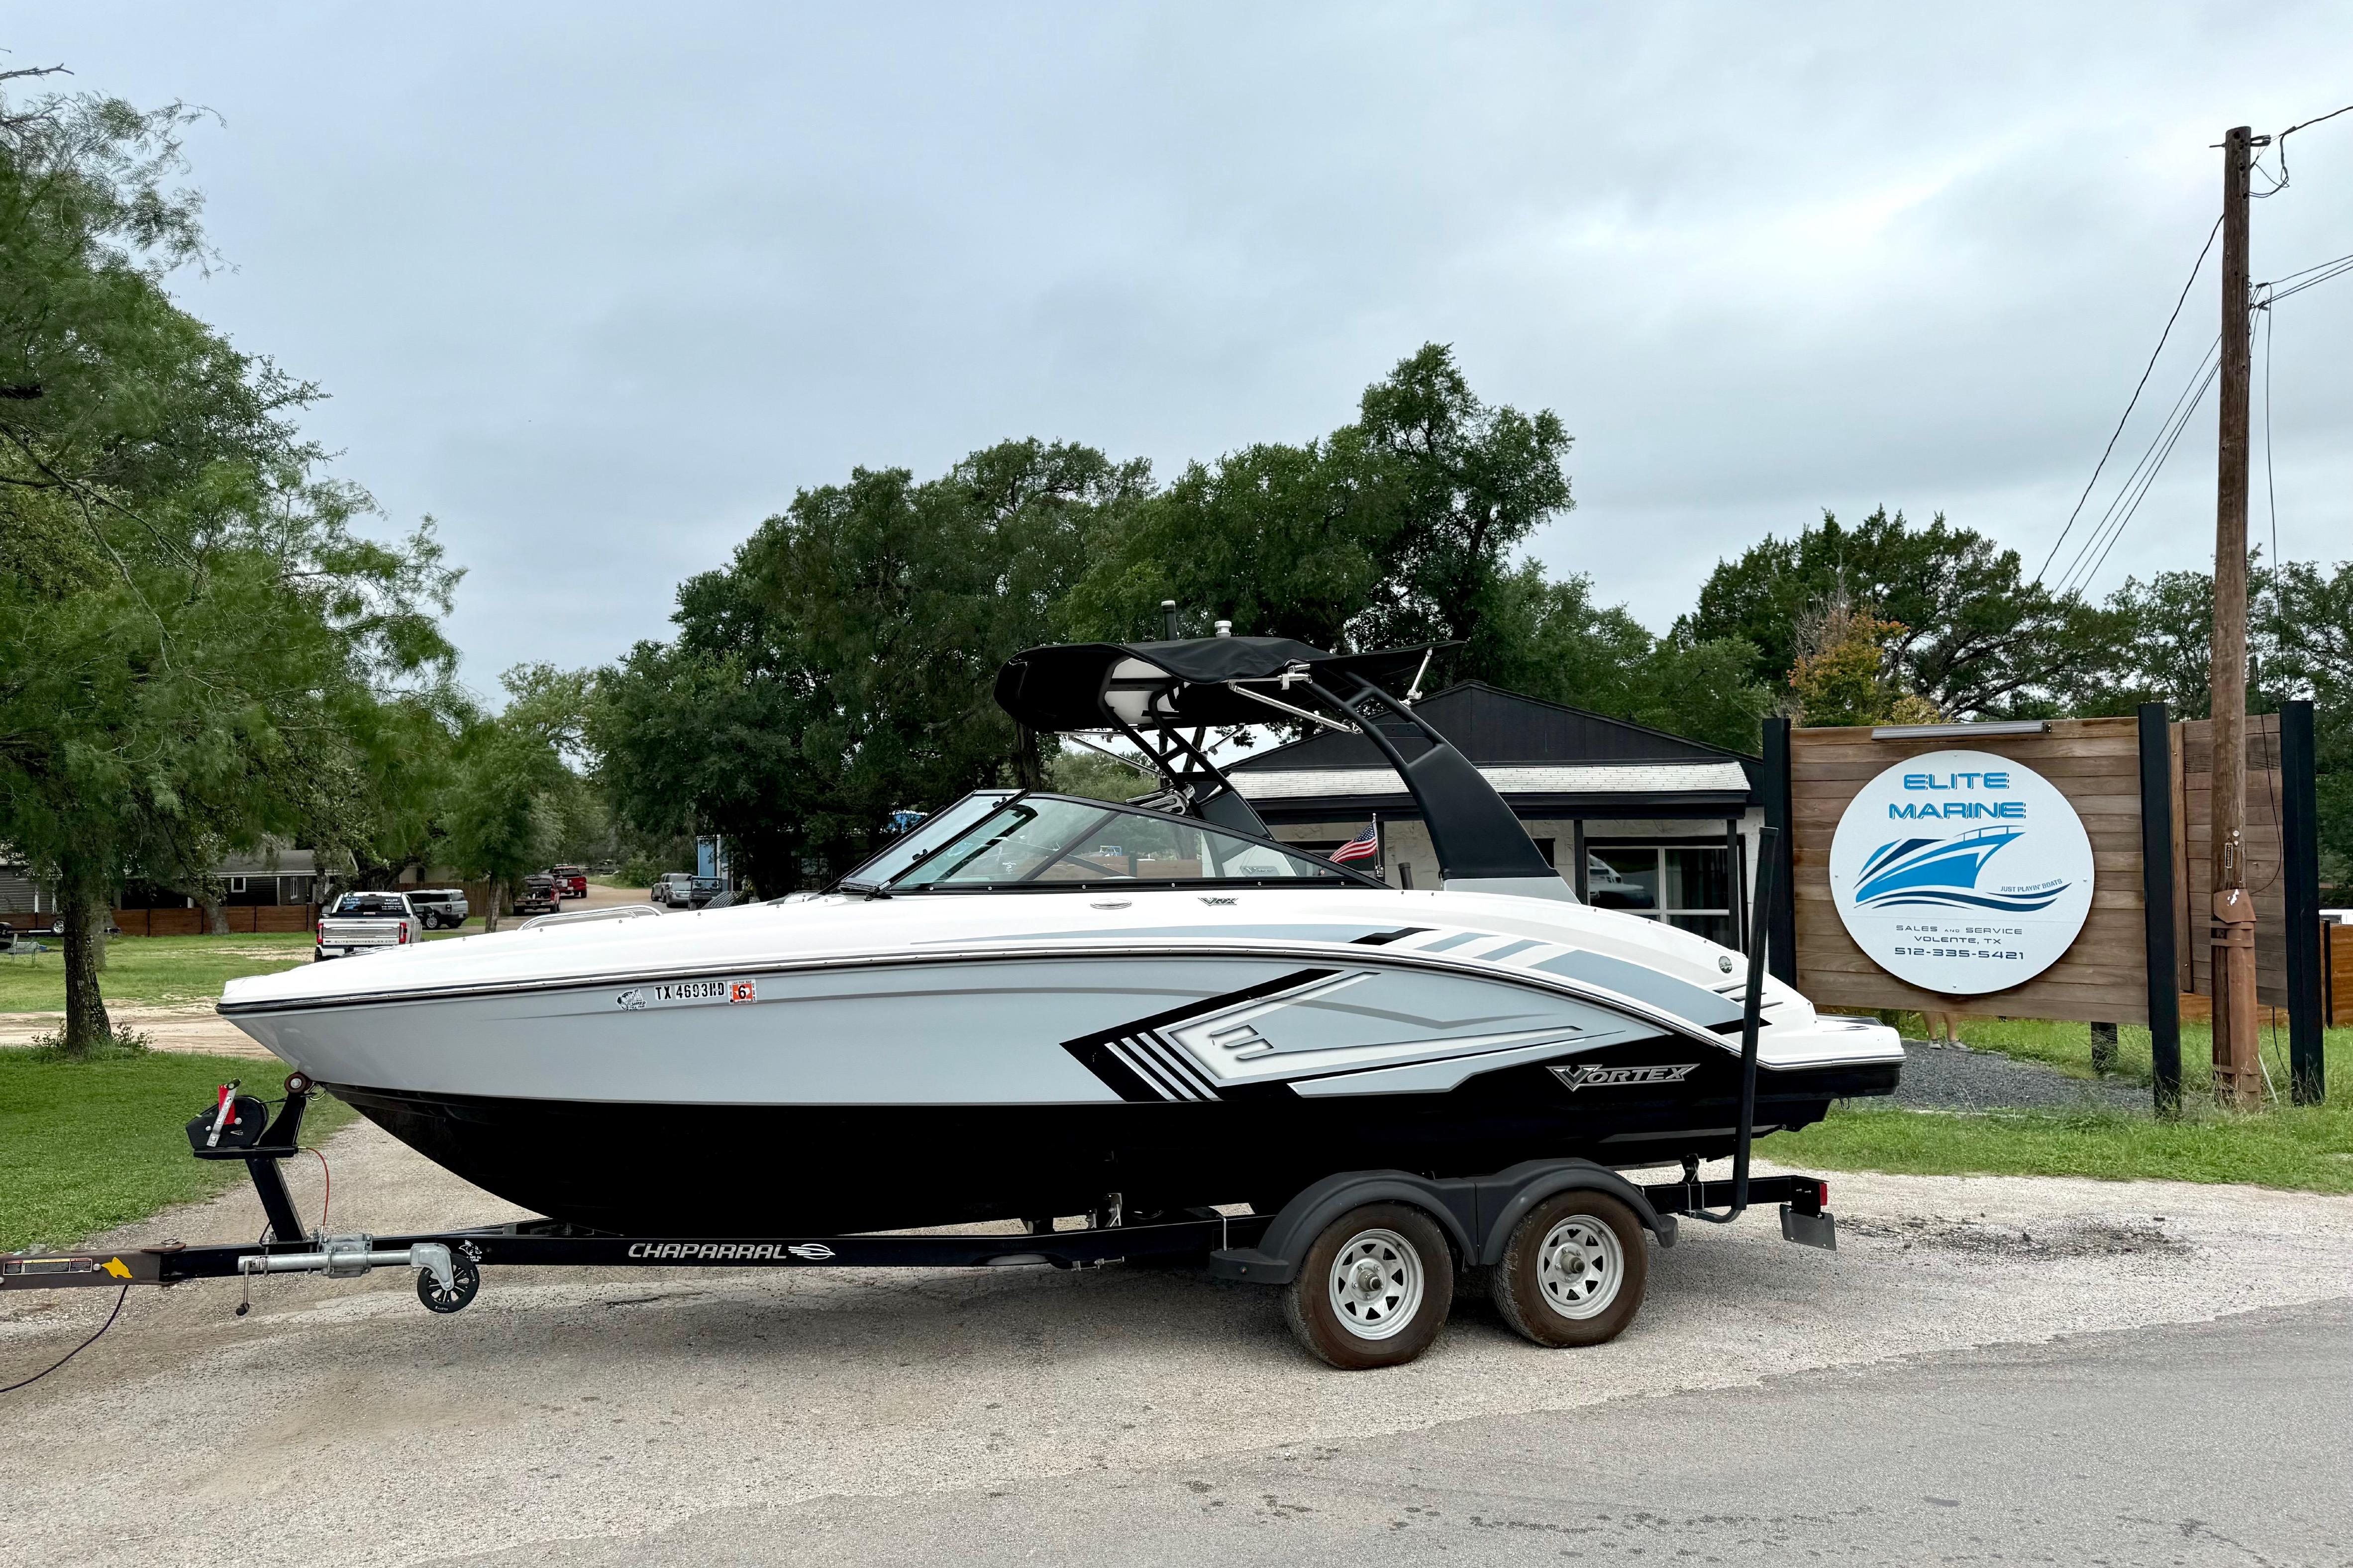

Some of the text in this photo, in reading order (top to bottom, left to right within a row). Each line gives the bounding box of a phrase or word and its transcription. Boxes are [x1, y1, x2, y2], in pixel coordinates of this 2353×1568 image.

[1904, 772, 2009, 790] ELITE
[1889, 801, 2026, 819] MARINE
[2042, 879, 2062, 889] BOATS
[1914, 936, 1979, 944] VOLENTE,
[1895, 947, 2024, 960] 512-335-5421
[655, 985, 672, 1000] TX
[676, 982, 724, 998] 4693HD
[738, 985, 746, 999] 6
[1545, 1063, 1701, 1092] VORTEX
[628, 1243, 787, 1259] CHAPARRAL
